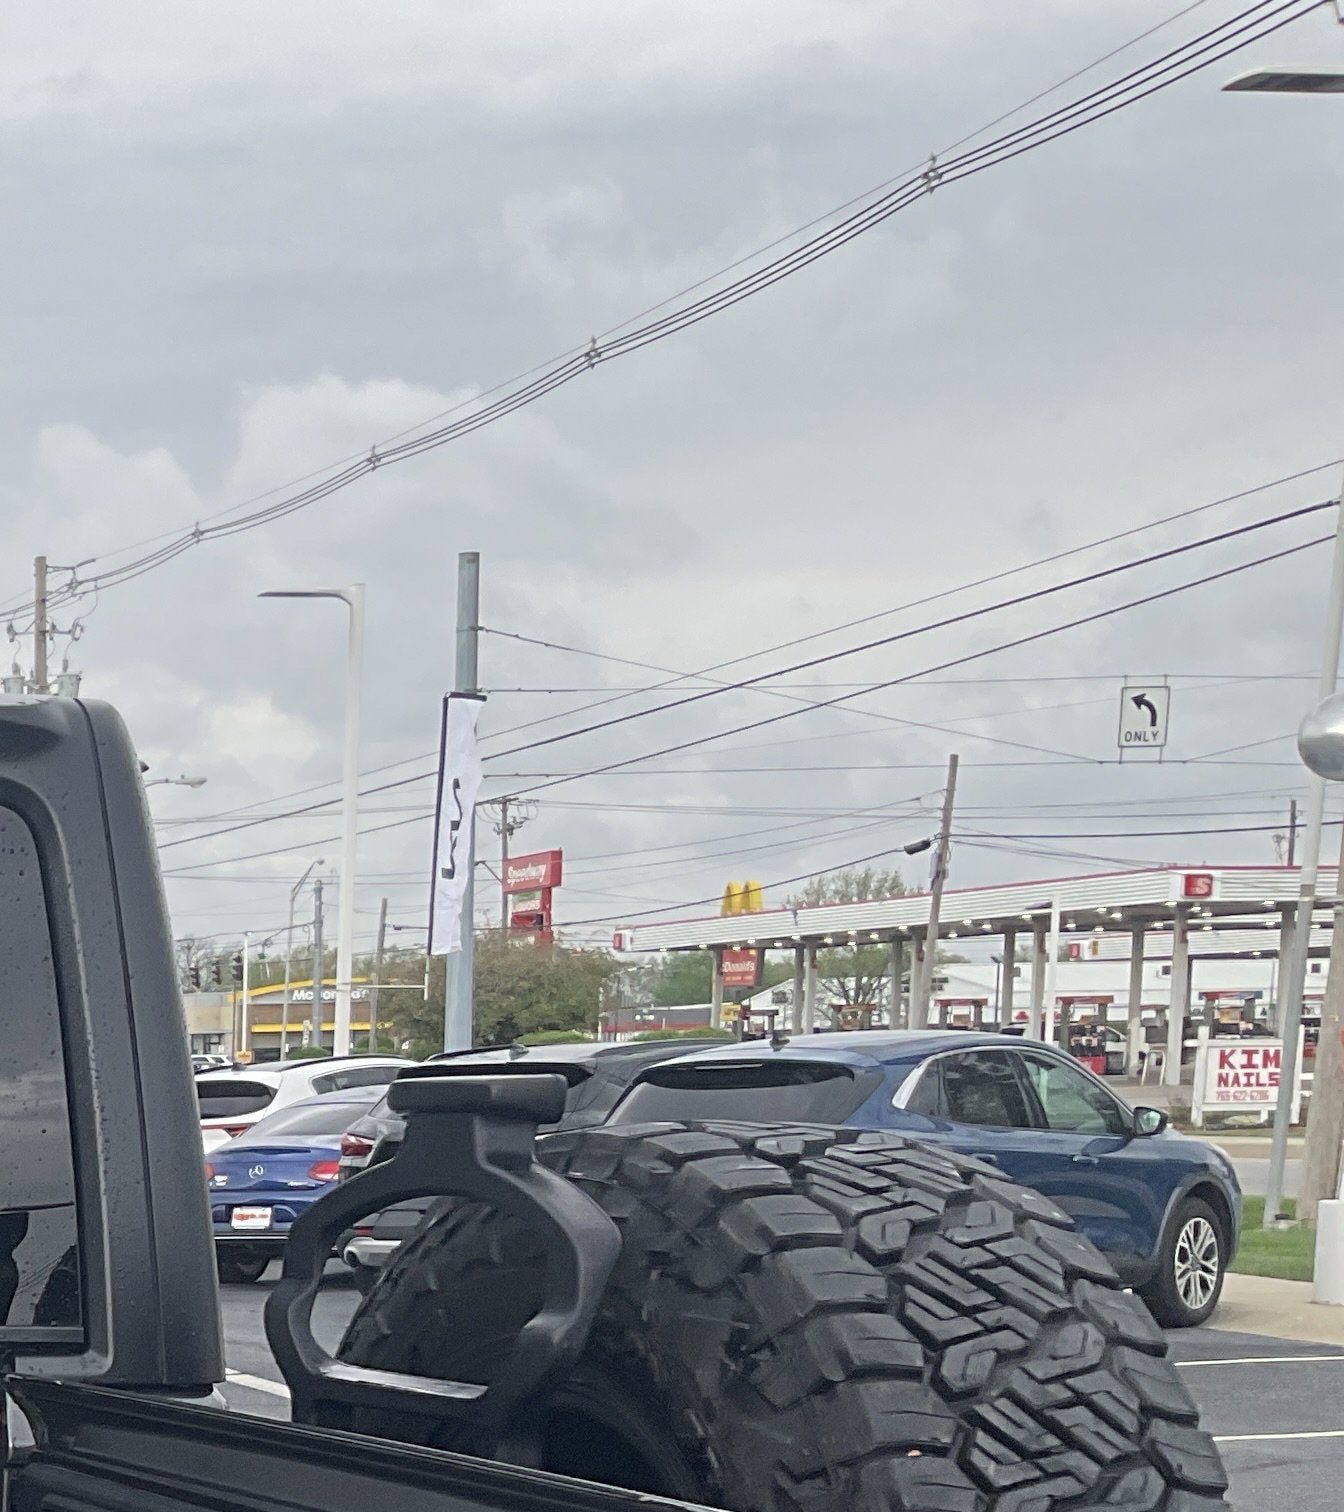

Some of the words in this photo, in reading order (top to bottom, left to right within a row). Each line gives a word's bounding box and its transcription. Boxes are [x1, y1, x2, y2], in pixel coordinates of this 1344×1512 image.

[1124, 730, 1160, 743] ONLY
[506, 862, 547, 889] Speedway
[1218, 1049, 1281, 1069] KIM
[1217, 1072, 1280, 1088] NAILS
